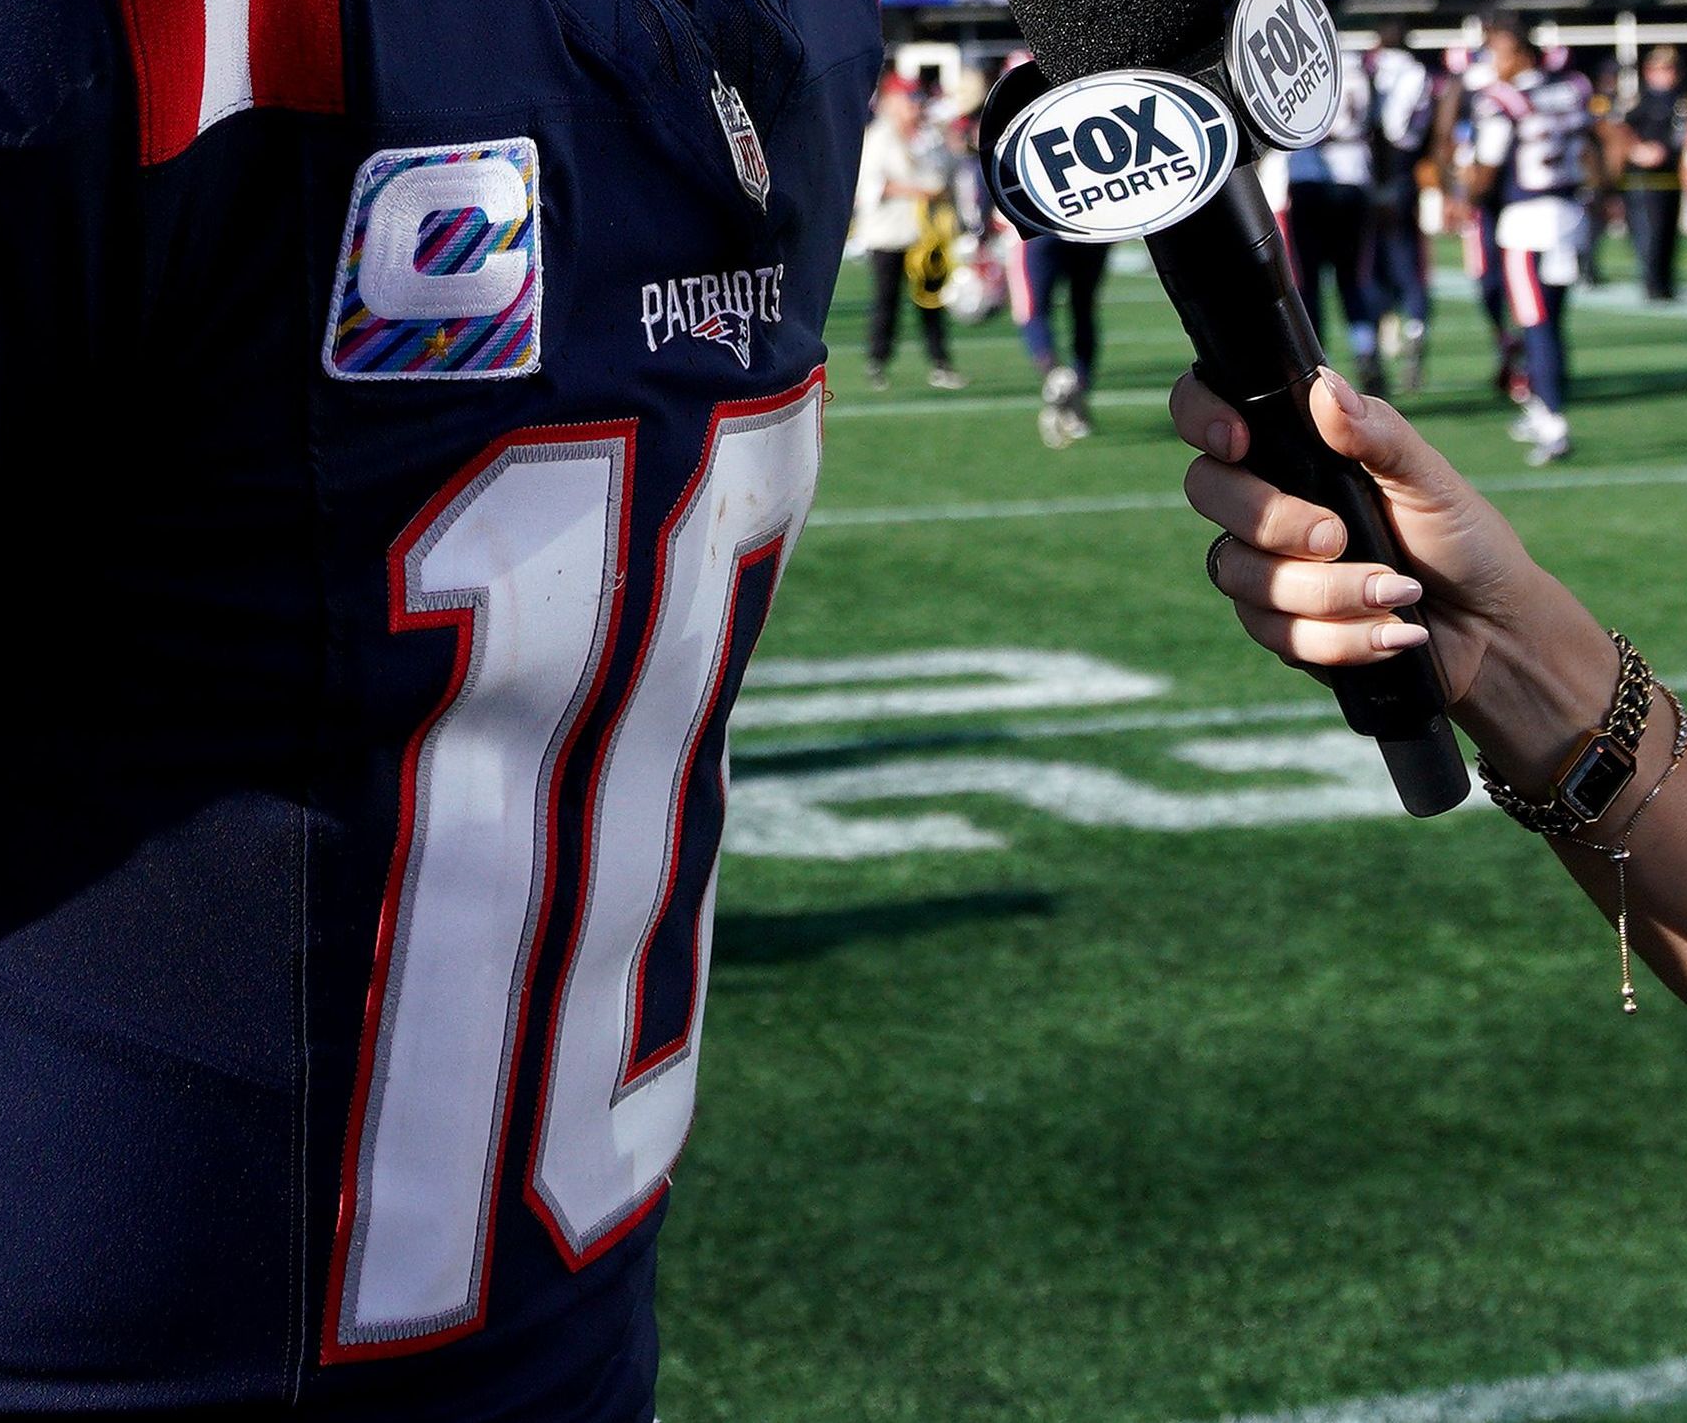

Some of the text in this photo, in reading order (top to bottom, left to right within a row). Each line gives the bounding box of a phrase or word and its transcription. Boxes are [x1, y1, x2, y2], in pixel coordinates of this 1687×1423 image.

[1277, 55, 1330, 124] SPORTS
[1030, 94, 1184, 193] FOX
[1058, 157, 1197, 218] SPORTS
[359, 159, 529, 320] C
[641, 263, 785, 353] PATRIOTS
[320, 364, 826, 1364] 10
